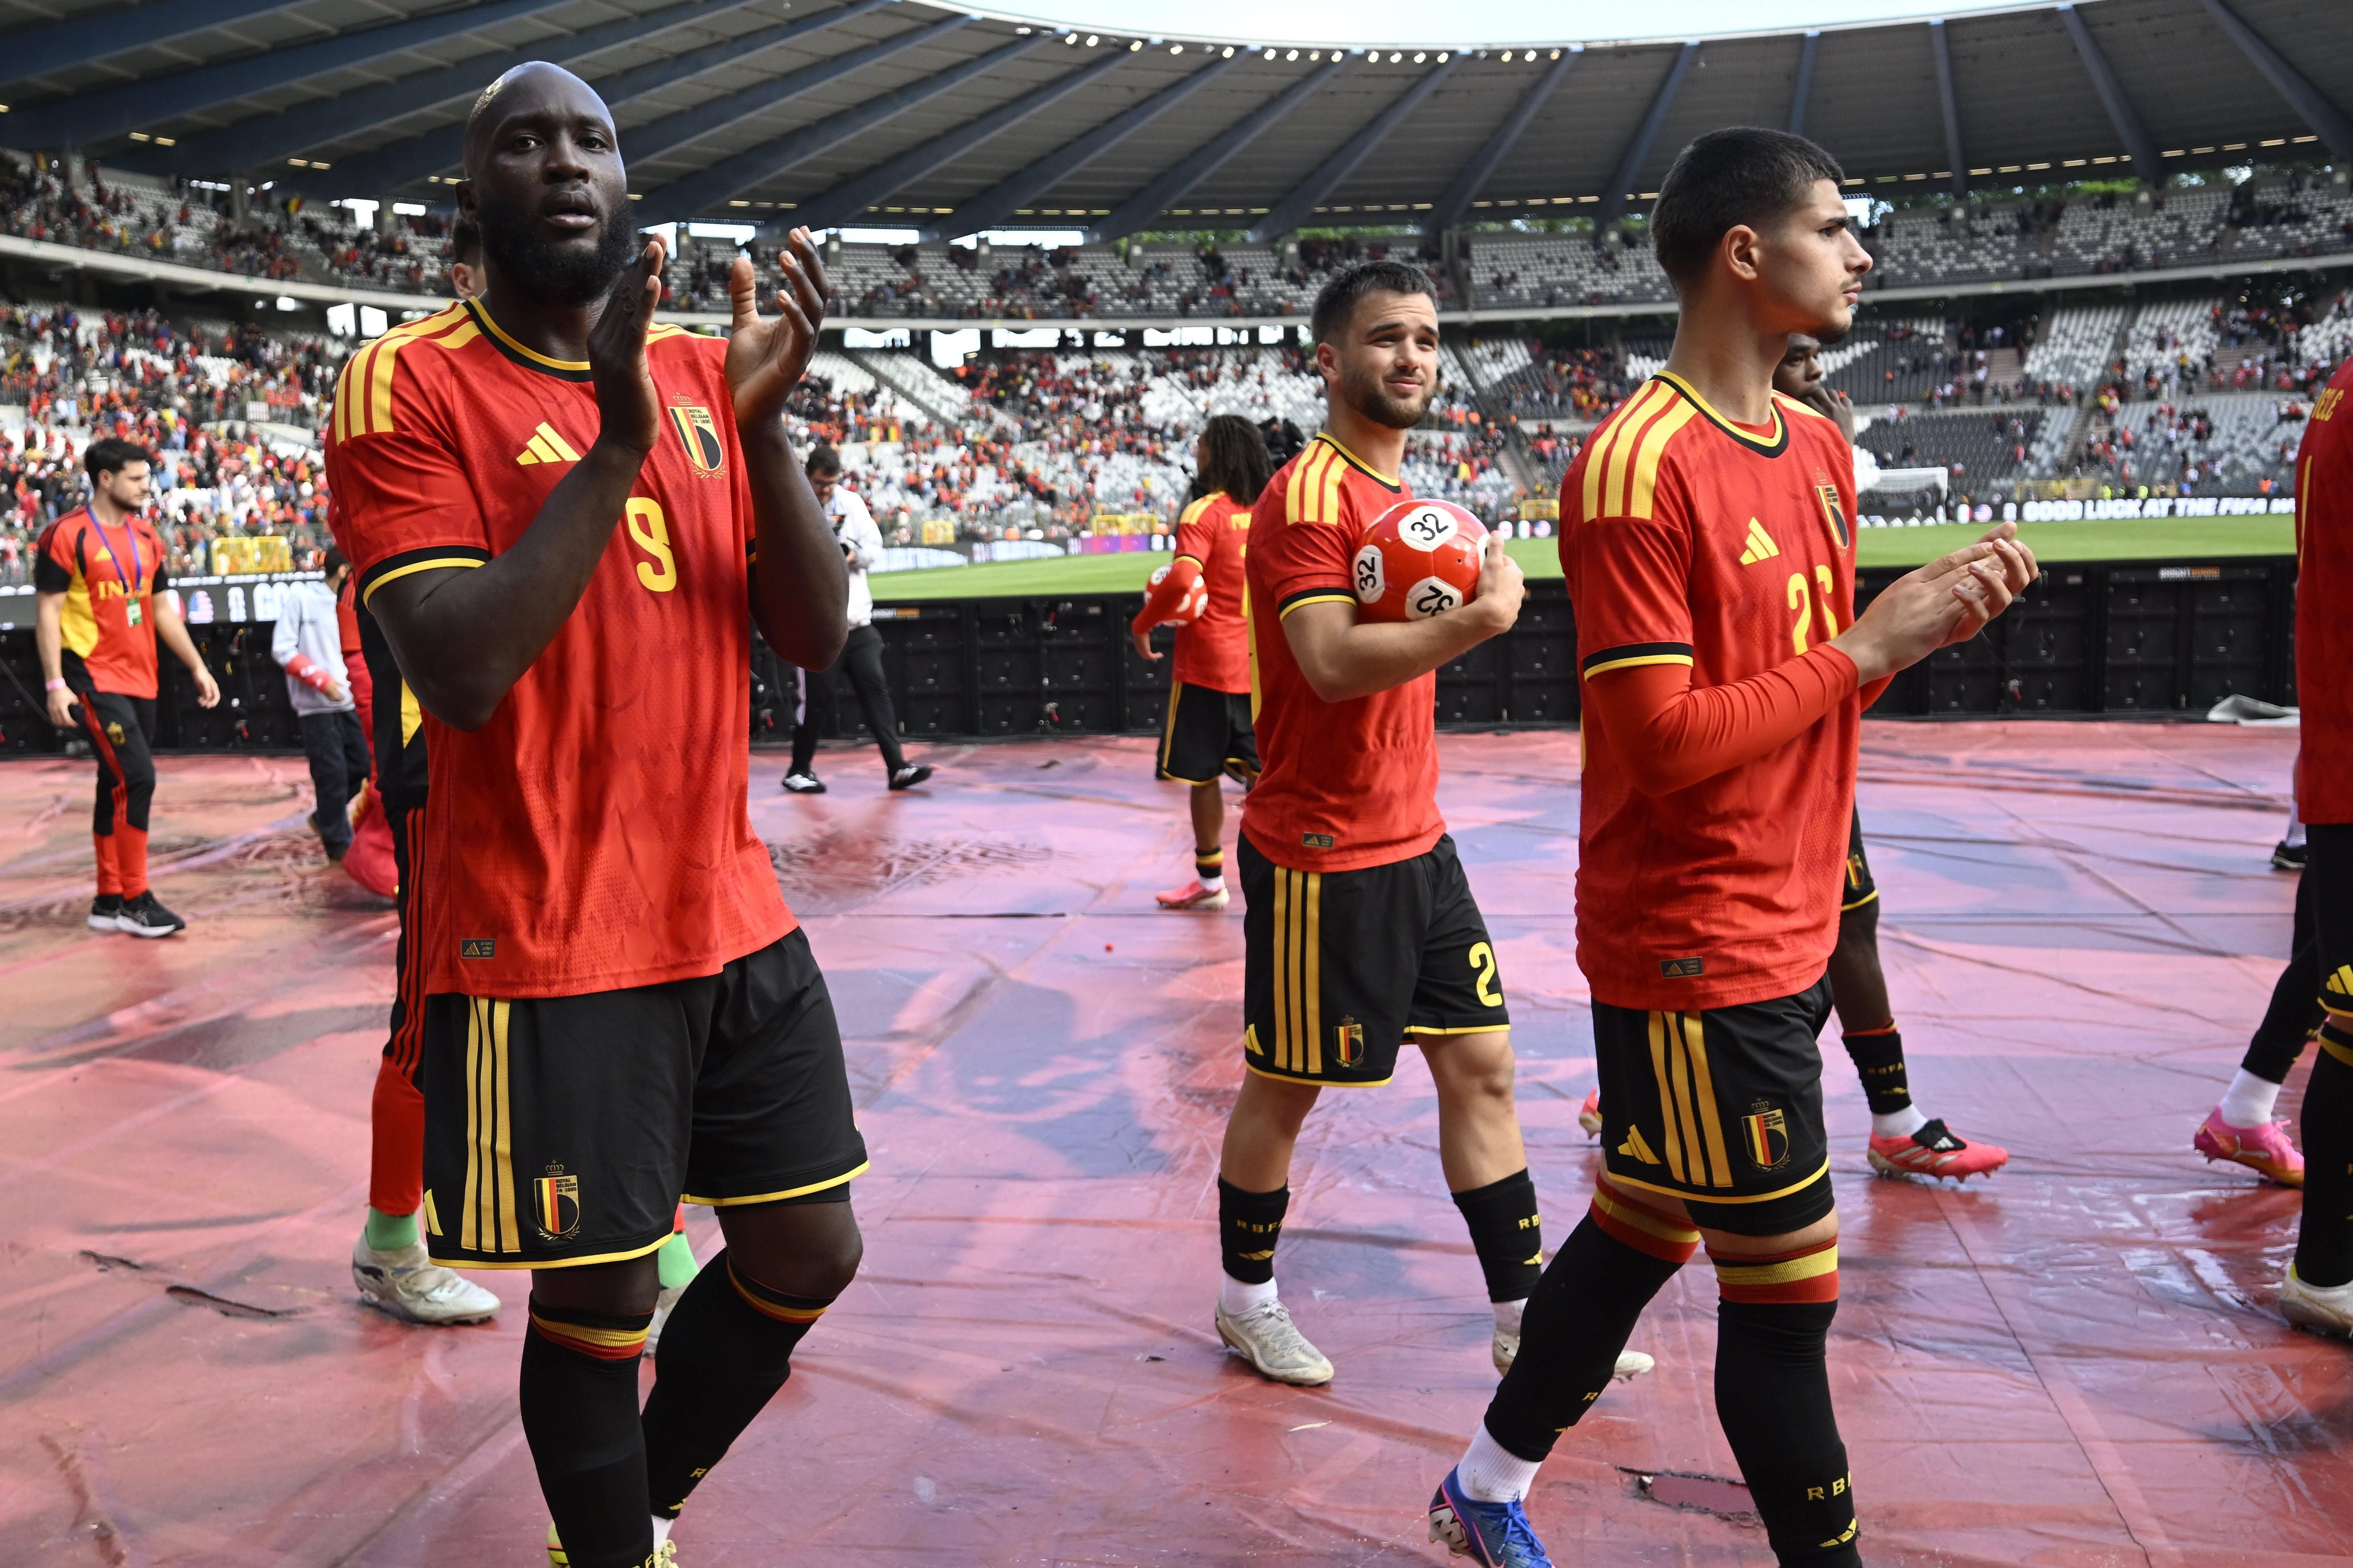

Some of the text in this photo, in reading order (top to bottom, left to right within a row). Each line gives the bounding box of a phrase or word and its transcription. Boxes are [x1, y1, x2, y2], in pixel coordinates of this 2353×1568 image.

[2083, 498, 2142, 520] LUCK
[2141, 498, 2173, 518] AT
[2174, 498, 2218, 517] THE
[2217, 498, 2267, 516] FIFA
[1411, 513, 1449, 541] 32
[625, 497, 677, 592] 9
[1357, 556, 1377, 591] 32
[1469, 942, 1503, 1007] 2
[1807, 1470, 1851, 1501] RB
